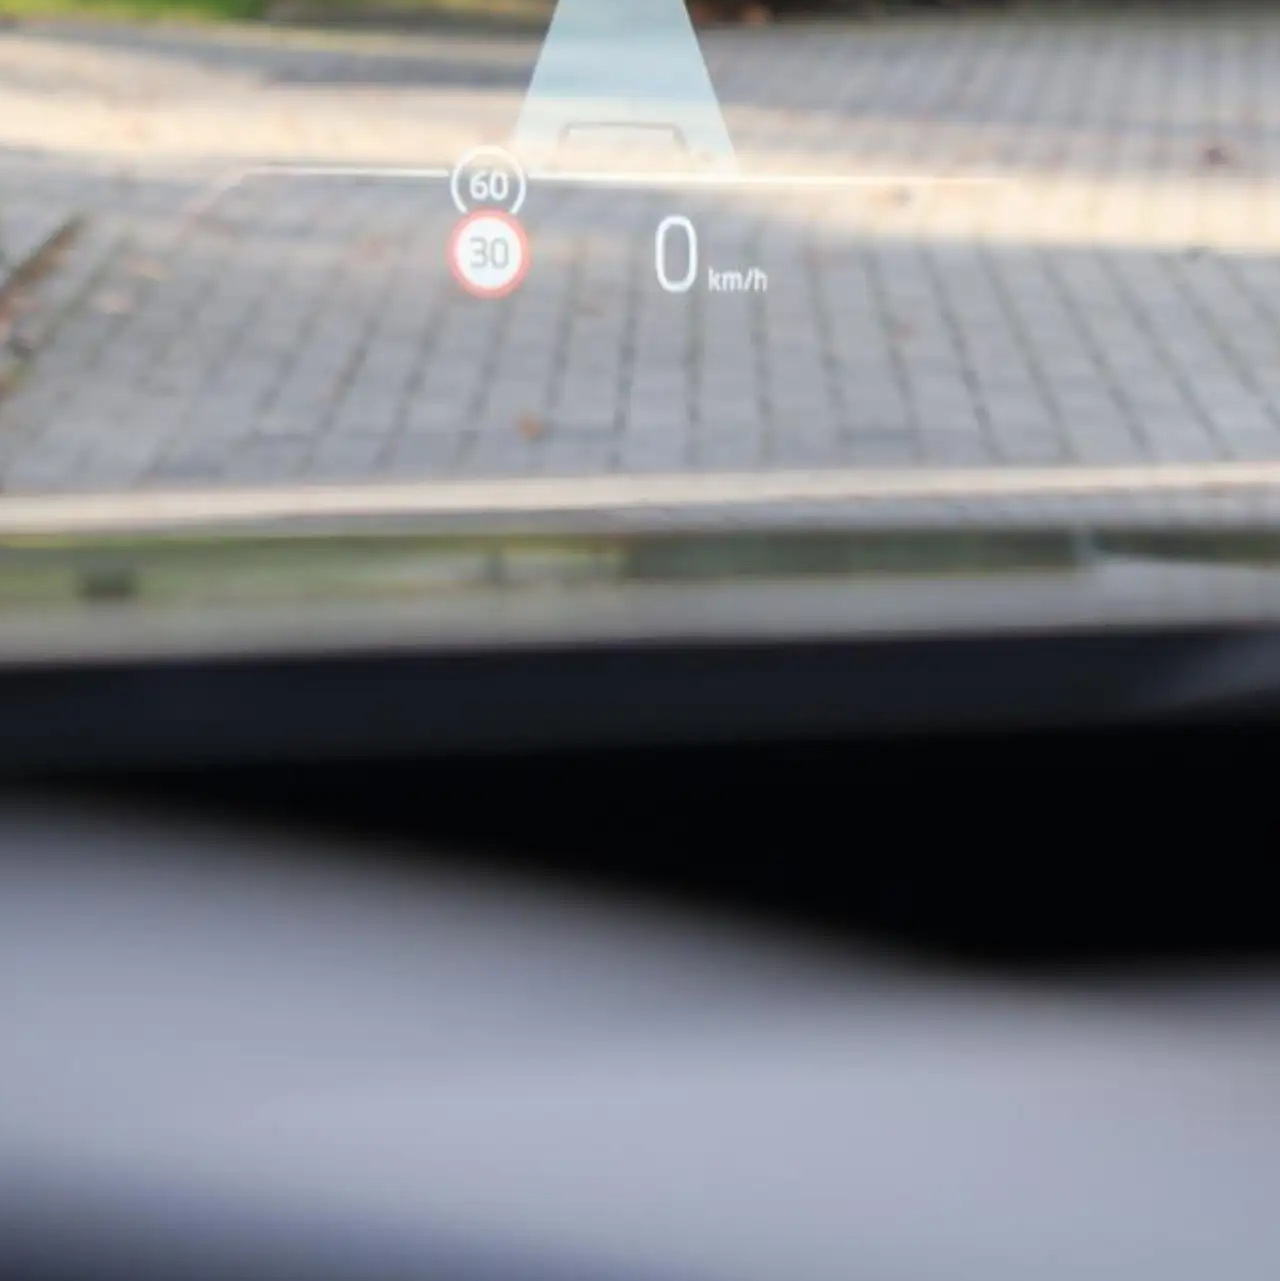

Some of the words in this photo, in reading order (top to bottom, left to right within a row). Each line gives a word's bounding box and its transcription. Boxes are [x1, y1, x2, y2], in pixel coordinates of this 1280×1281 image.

[469, 170, 509, 201] 60
[469, 236, 510, 270] 30
[655, 214, 698, 293] 0
[707, 267, 768, 293] km/h
